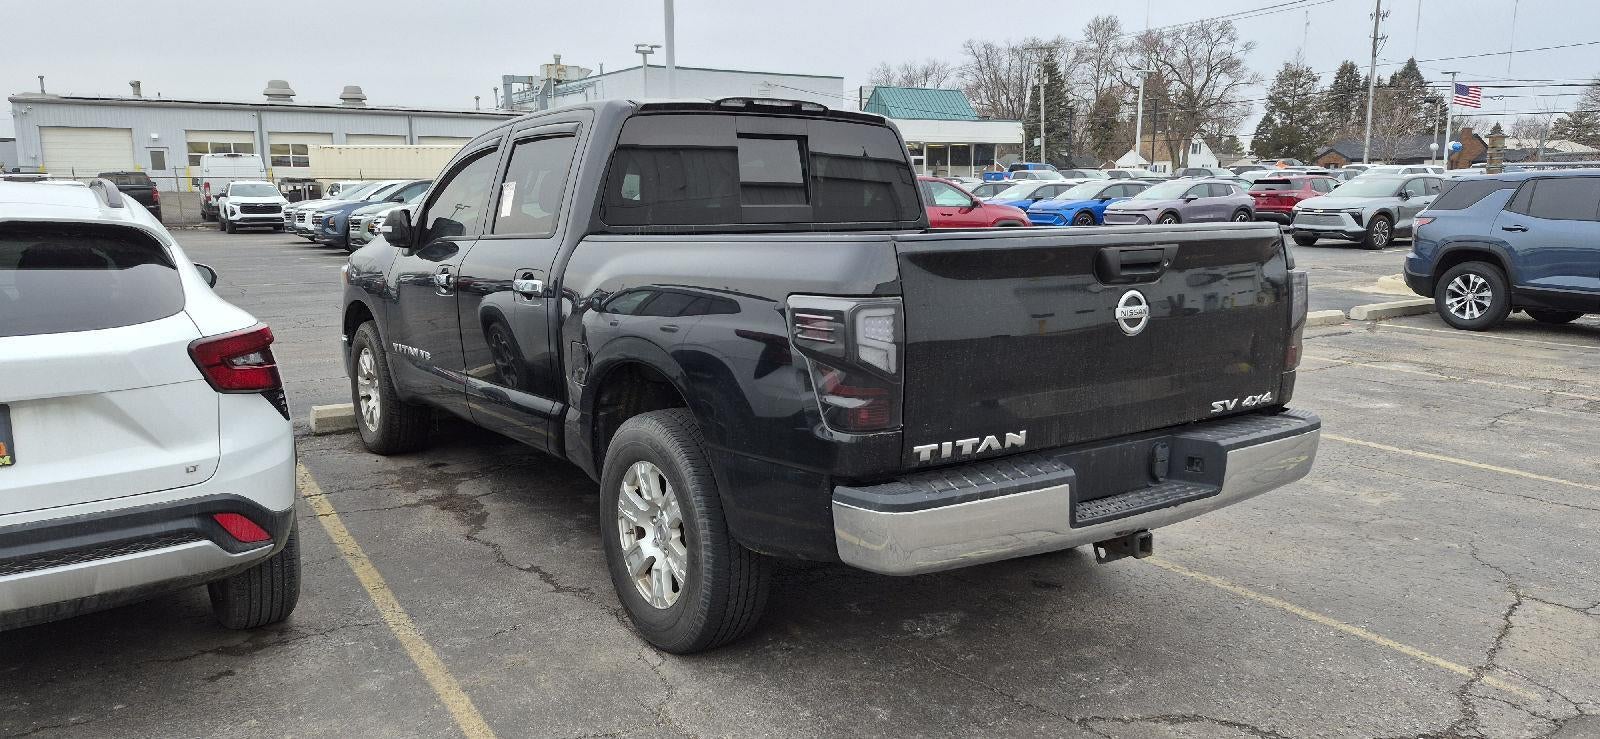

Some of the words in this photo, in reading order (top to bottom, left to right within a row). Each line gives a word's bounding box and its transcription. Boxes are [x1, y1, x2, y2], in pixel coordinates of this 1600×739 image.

[1120, 308, 1147, 317] NISSAN
[392, 342, 419, 357] TITAN
[1210, 398, 1239, 413] SV
[913, 429, 1027, 462] TITAN
